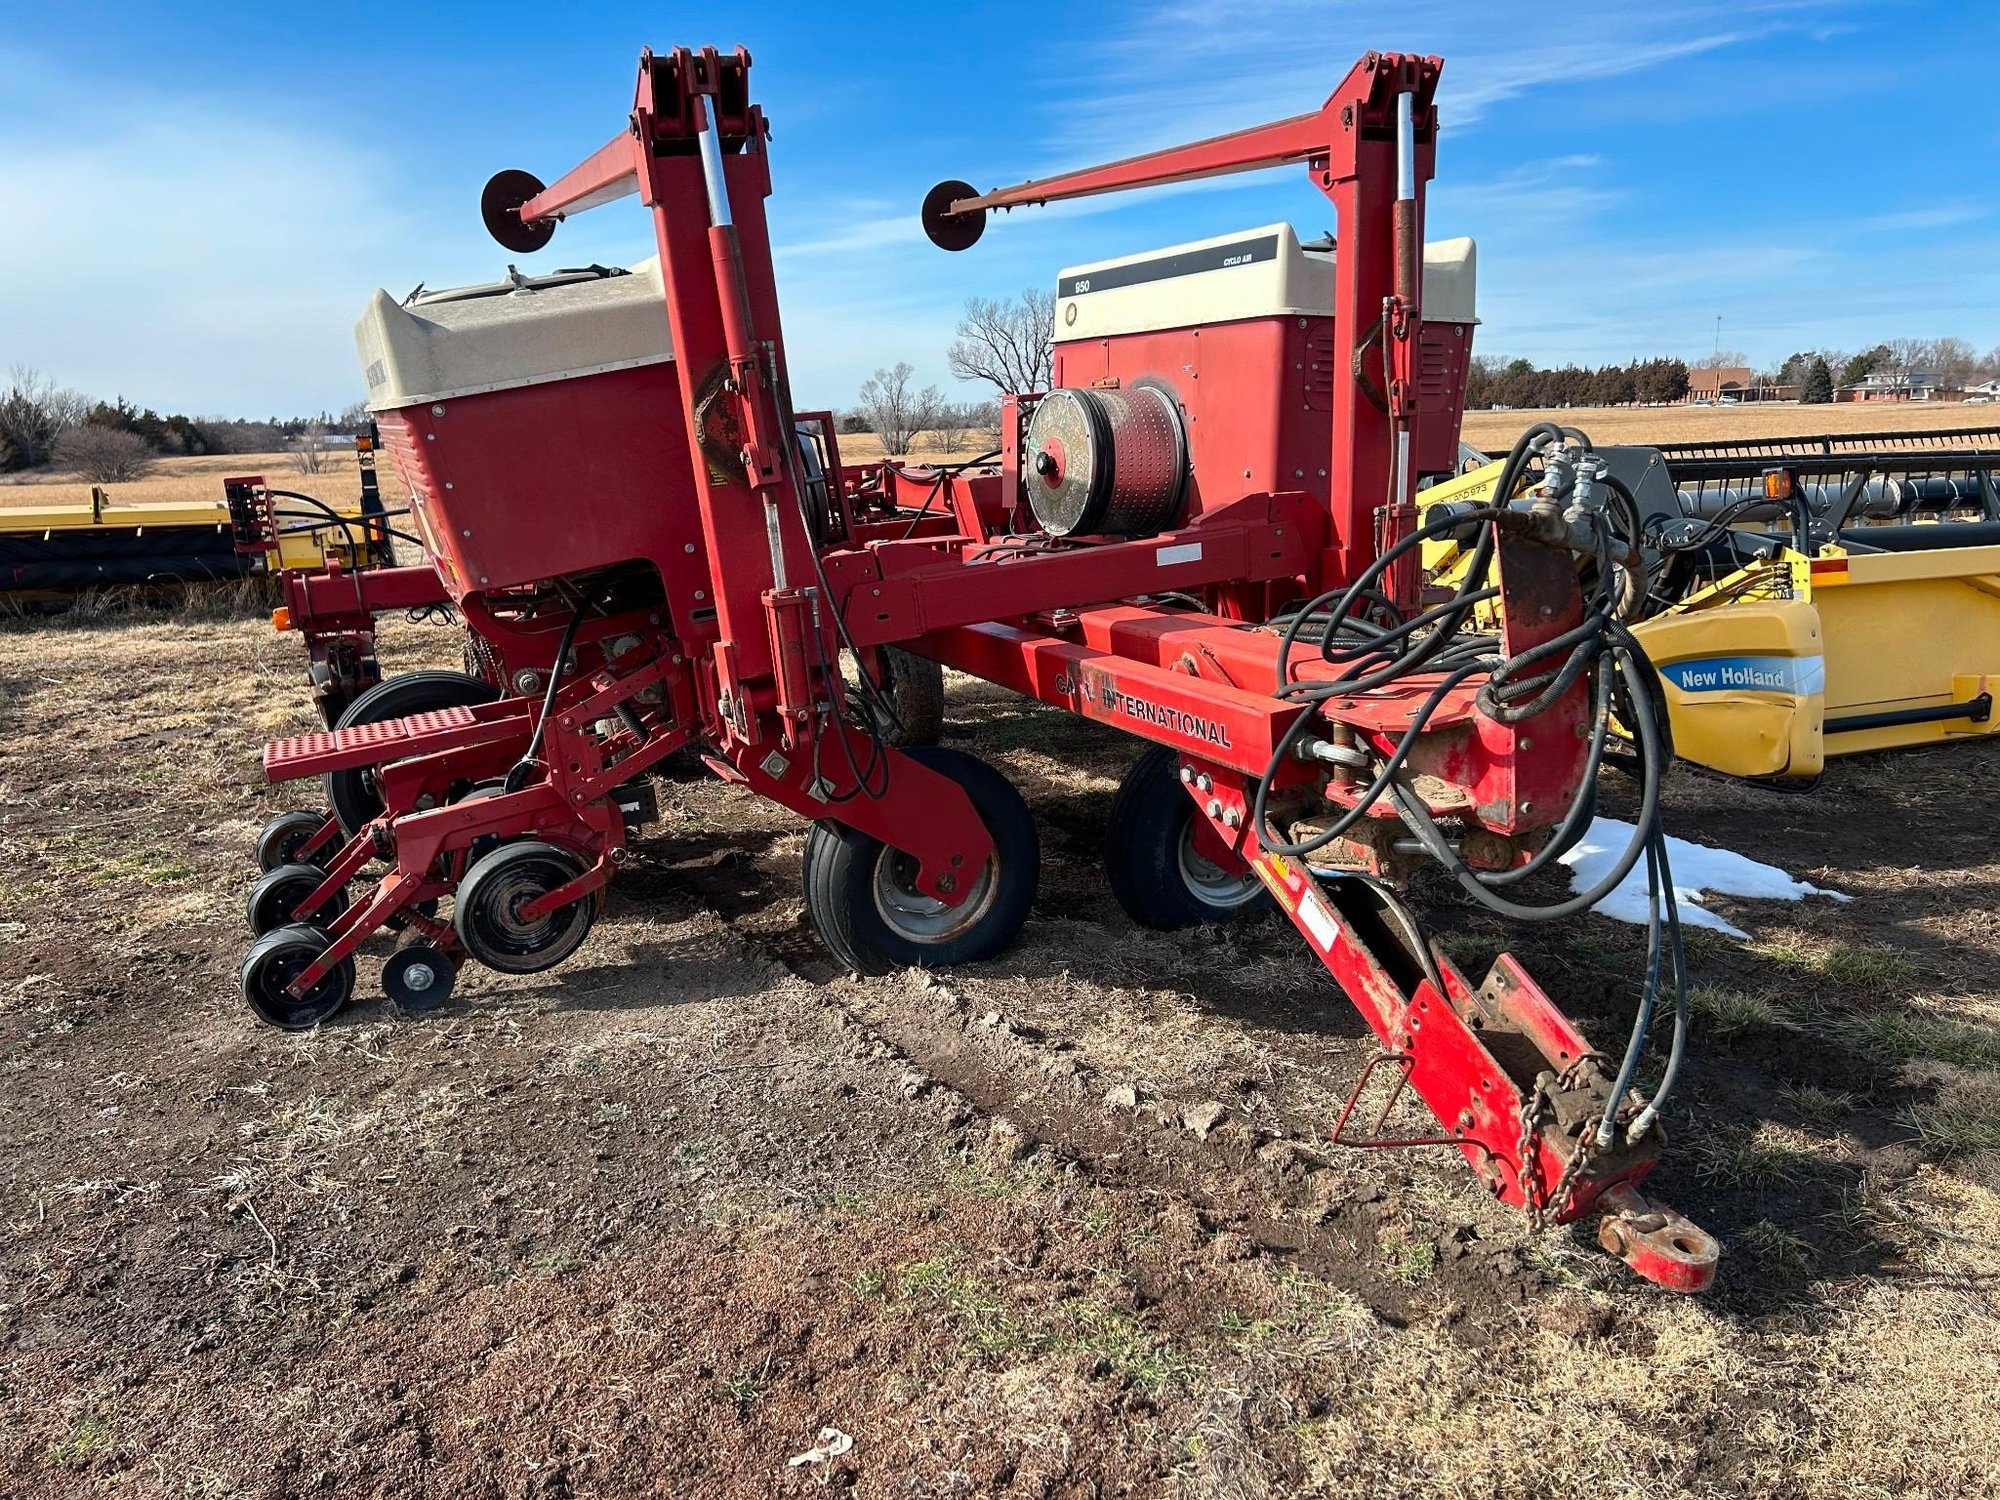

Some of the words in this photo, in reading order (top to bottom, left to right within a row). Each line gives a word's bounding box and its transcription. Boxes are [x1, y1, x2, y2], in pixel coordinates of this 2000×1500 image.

[1223, 256, 1242, 267] CYCLO
[1242, 253, 1253, 264] AIR
[1075, 279, 1090, 294] 950
[1470, 483, 1488, 496] 973
[1682, 670, 1717, 688] New
[1721, 667, 1785, 688] Holland
